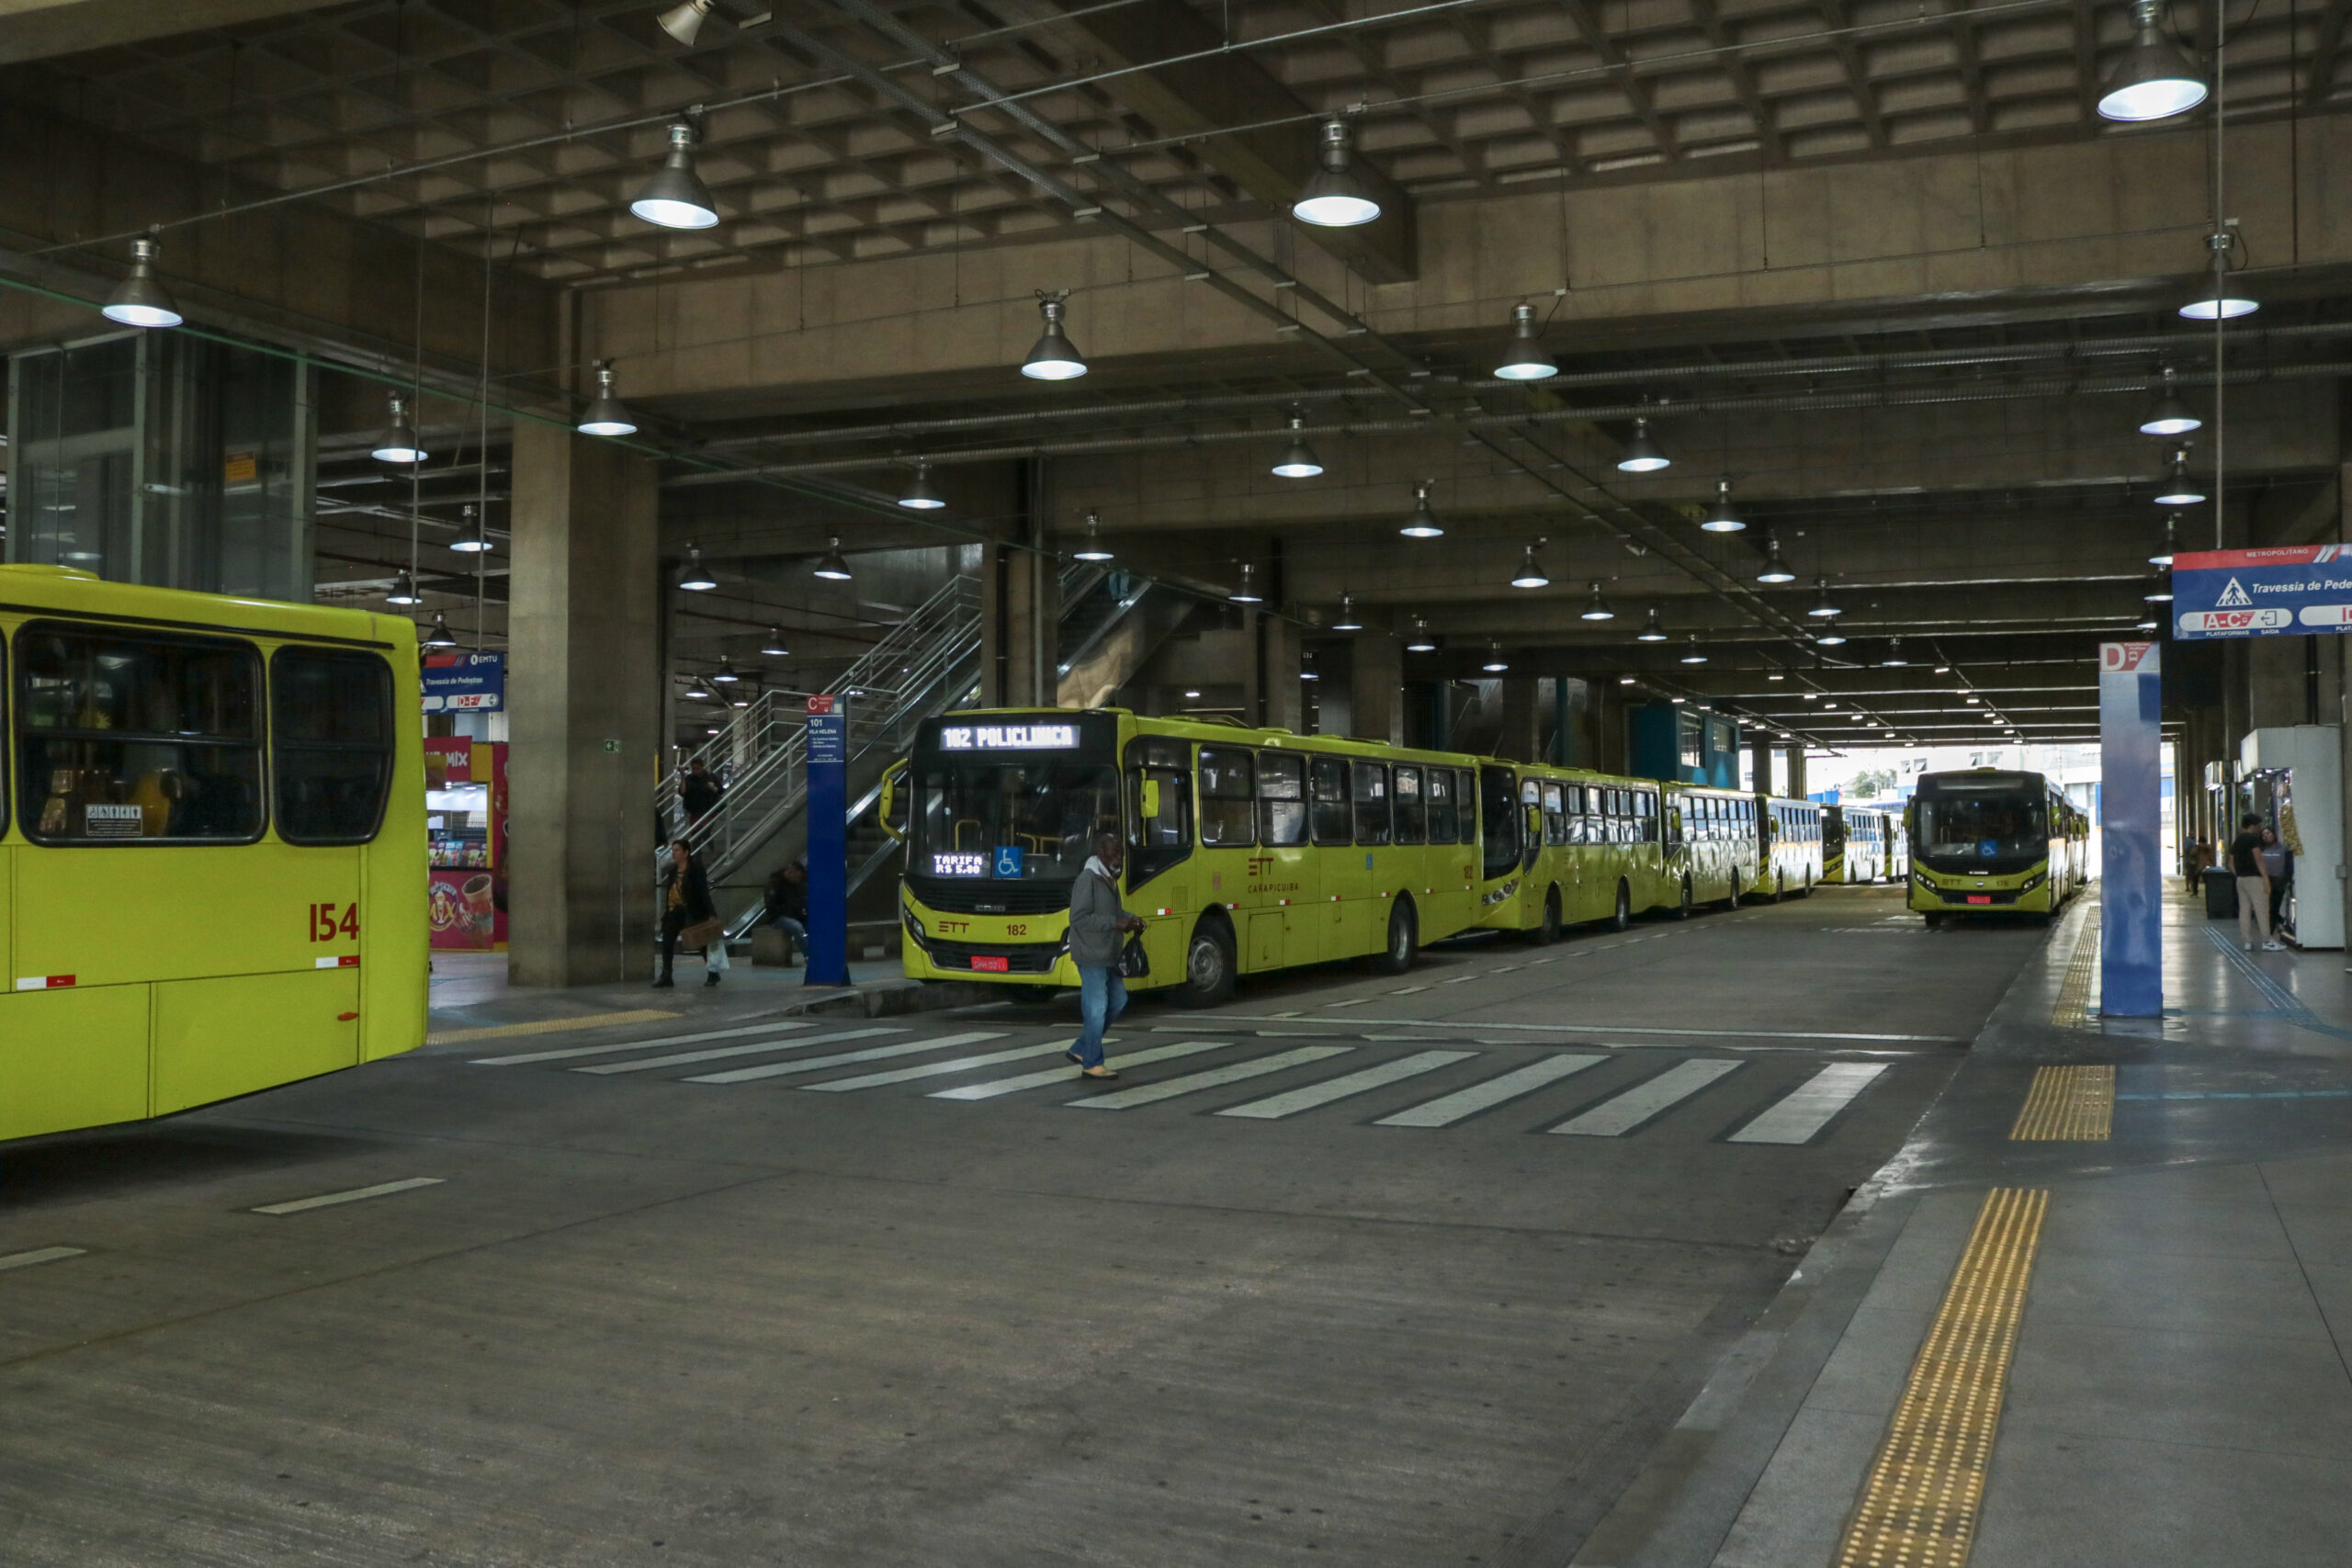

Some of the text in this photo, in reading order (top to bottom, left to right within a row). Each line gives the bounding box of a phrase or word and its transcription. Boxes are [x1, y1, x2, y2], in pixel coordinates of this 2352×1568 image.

[2246, 548, 2309, 558] METROPOLITANO
[2252, 581, 2304, 594] Travessia
[2307, 581, 2322, 591] de
[2206, 613, 2241, 628] A-C
[2100, 642, 2126, 671] D
[808, 697, 818, 710] C
[810, 718, 823, 727] 101
[944, 728, 971, 748] 102
[446, 751, 468, 767] MIX
[933, 855, 983, 865] TARIFA
[1249, 857, 1273, 876] ETT
[935, 865, 953, 874] R$
[310, 902, 360, 942] 154
[939, 921, 969, 933] ETT
[1006, 924, 1027, 936] 182
